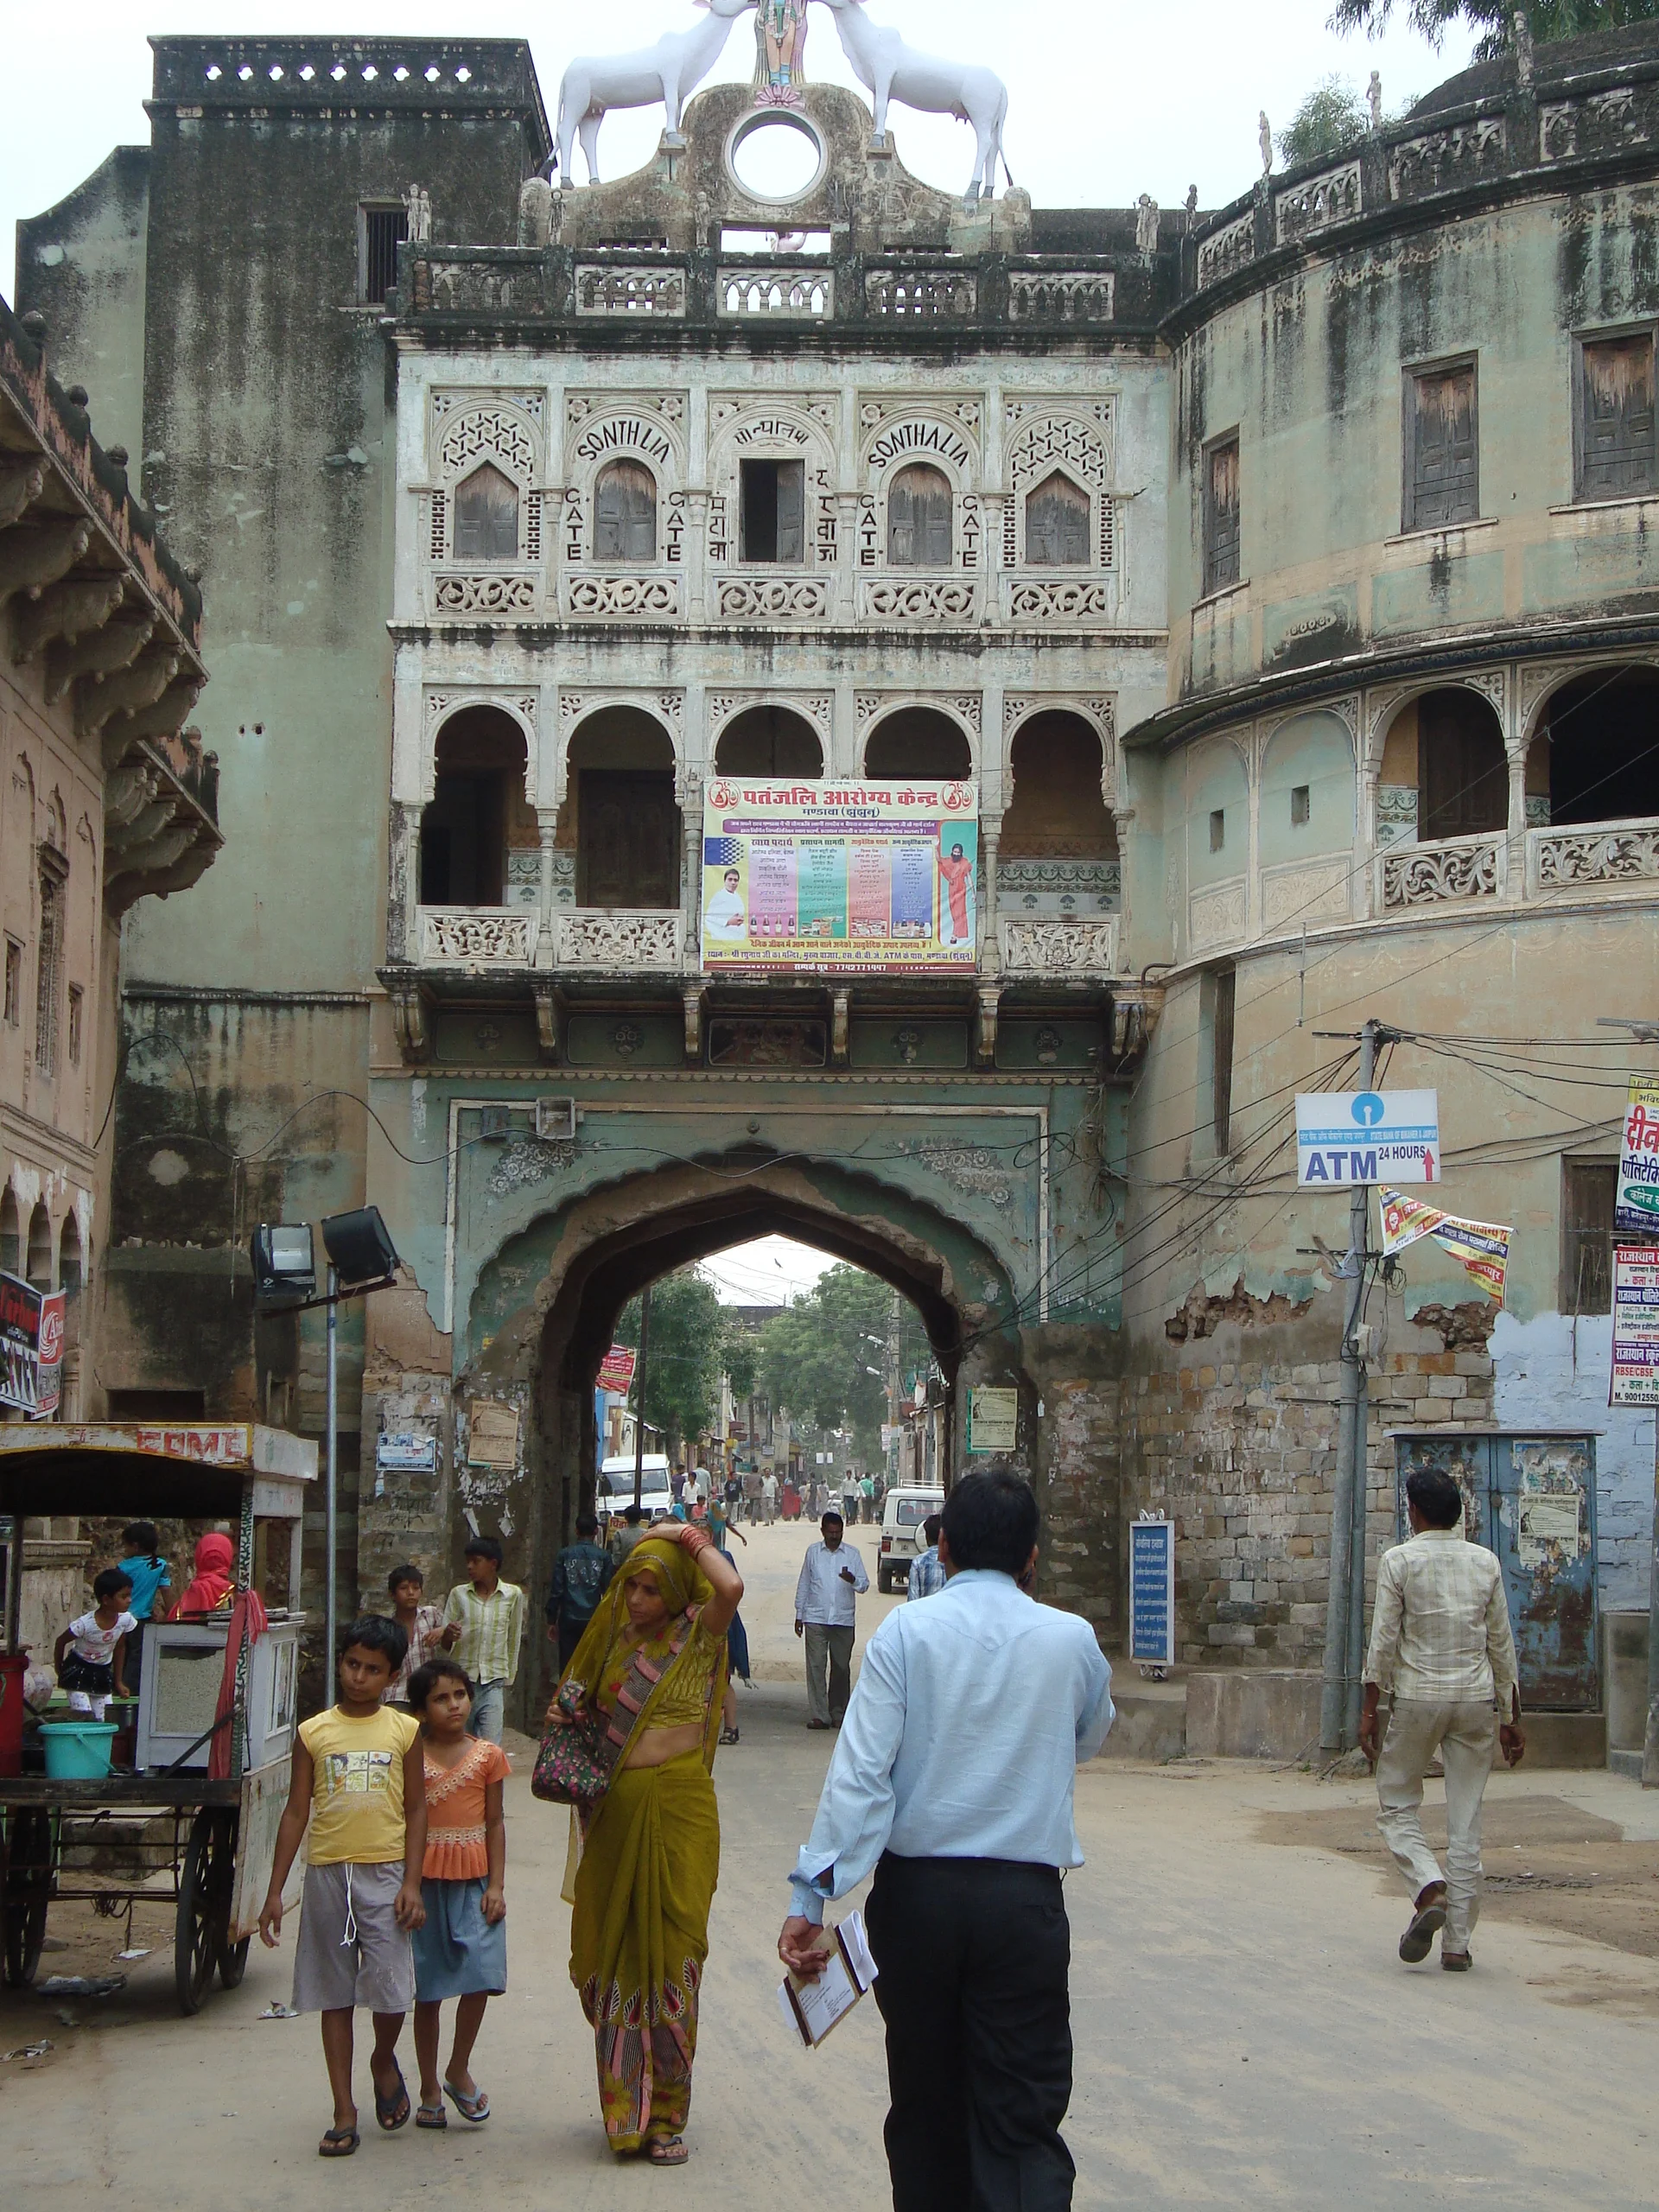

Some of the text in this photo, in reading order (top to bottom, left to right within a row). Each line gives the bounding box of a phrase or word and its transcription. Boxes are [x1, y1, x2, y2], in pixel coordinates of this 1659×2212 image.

[868, 423, 969, 467] SONTHALIA
[565, 488, 583, 560] GATE
[667, 491, 685, 562] GATE
[860, 494, 877, 566] GATE
[962, 495, 980, 567] GATE
[743, 786, 938, 808] पतंजलि आरोग्य केन्द्र
[1305, 1151, 1377, 1181] ATM
[1378, 1146, 1426, 1160] 24 HOURS
[1618, 1250, 1656, 1263] राजस्थान
[1615, 1366, 1654, 1377] RBSE/CBSE
[1614, 1391, 1659, 1402] M. 90012550
